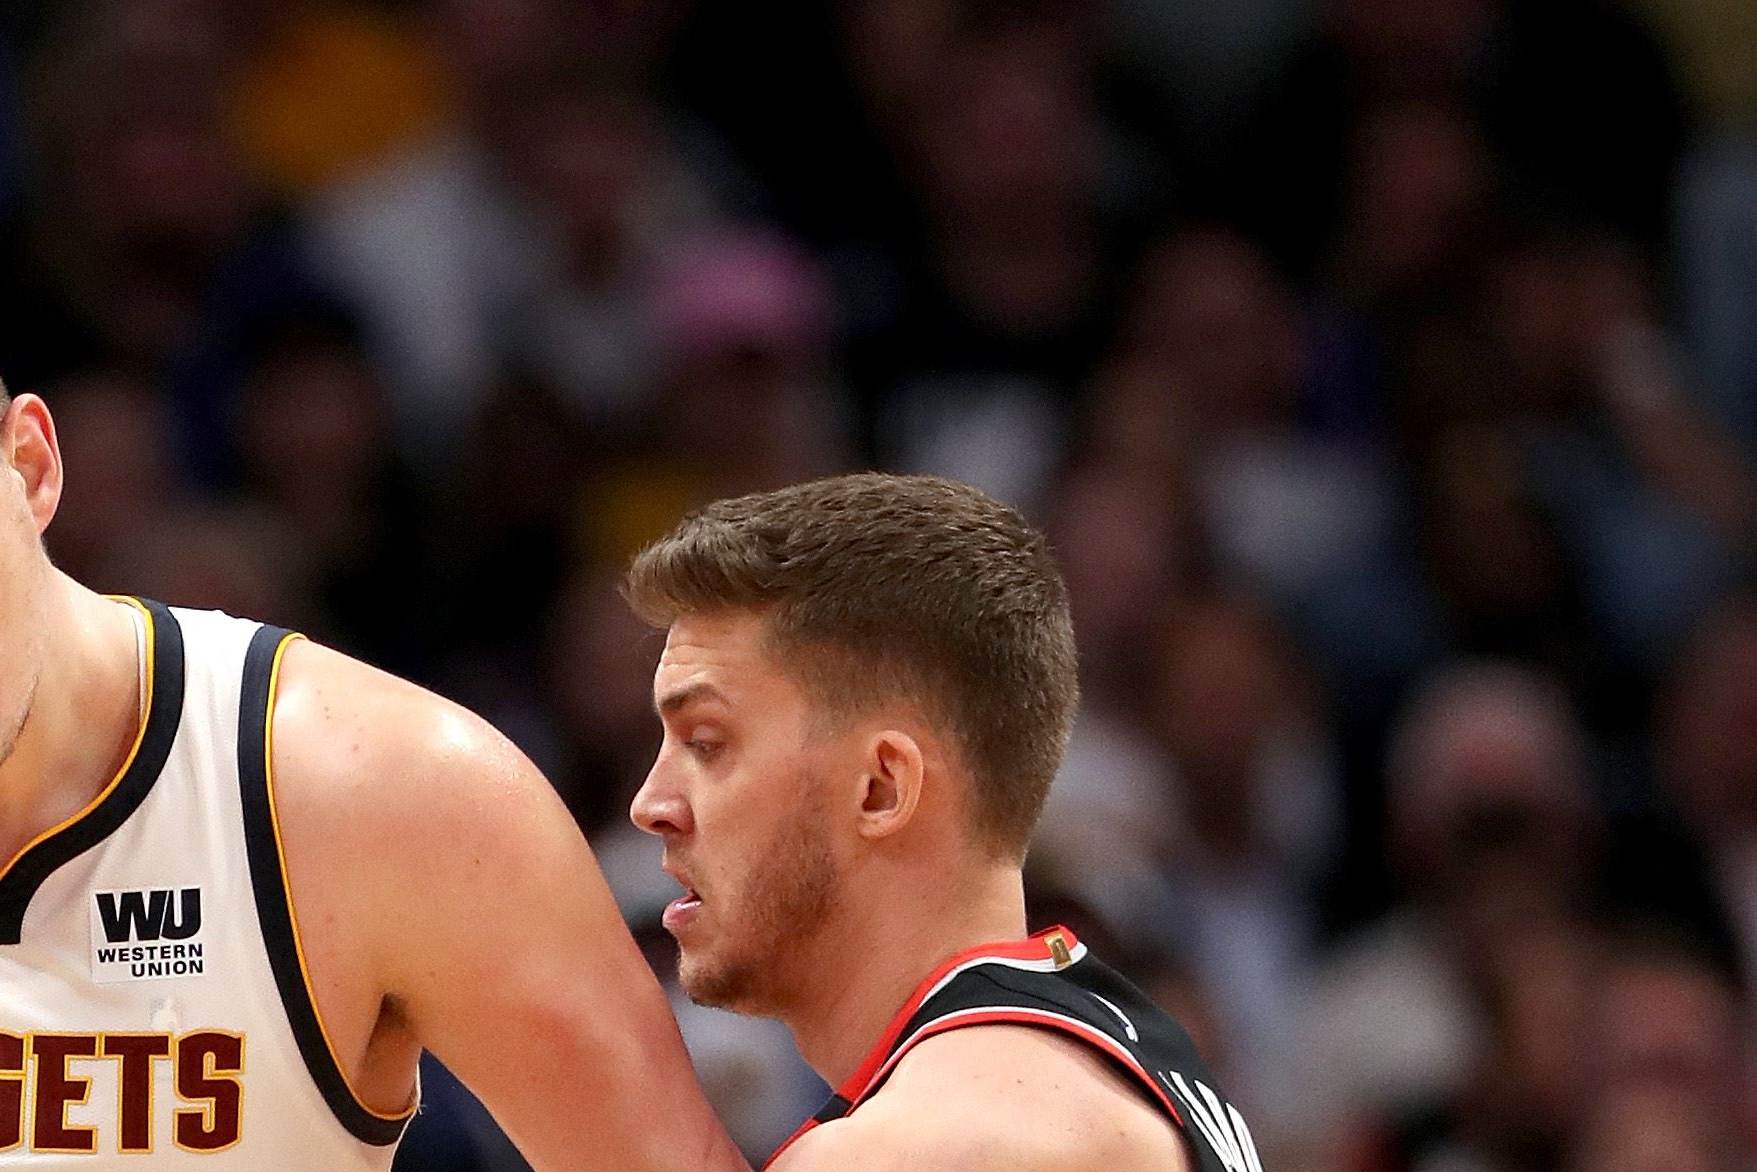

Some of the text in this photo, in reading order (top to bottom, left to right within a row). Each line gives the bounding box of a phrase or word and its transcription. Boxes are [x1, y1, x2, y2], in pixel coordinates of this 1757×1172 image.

[95, 888, 201, 943] WU
[97, 944, 203, 963] WESTERN
[131, 960, 204, 978] UNION
